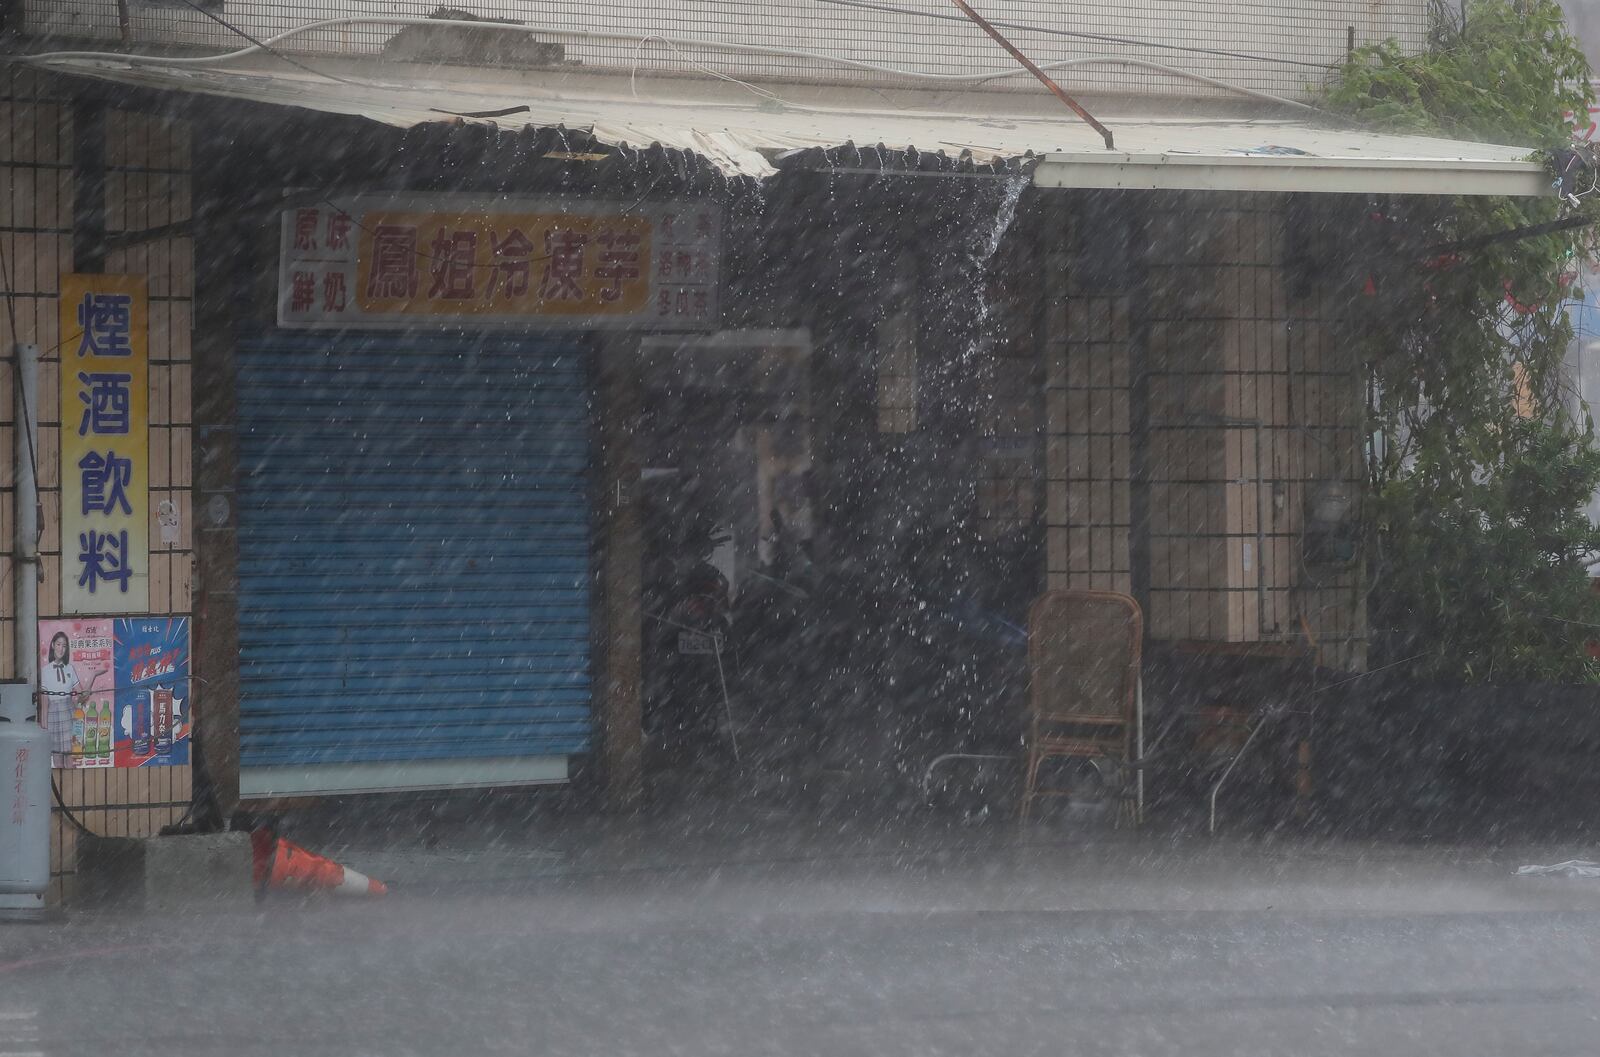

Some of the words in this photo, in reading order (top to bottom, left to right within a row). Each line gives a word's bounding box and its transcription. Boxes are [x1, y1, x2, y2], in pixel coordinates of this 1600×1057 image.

[294, 208, 352, 250] 原味
[291, 270, 347, 313] 鮮奶
[366, 224, 642, 300] 鳳姐冷凍芋
[77, 291, 134, 594] 煙酒飲料
